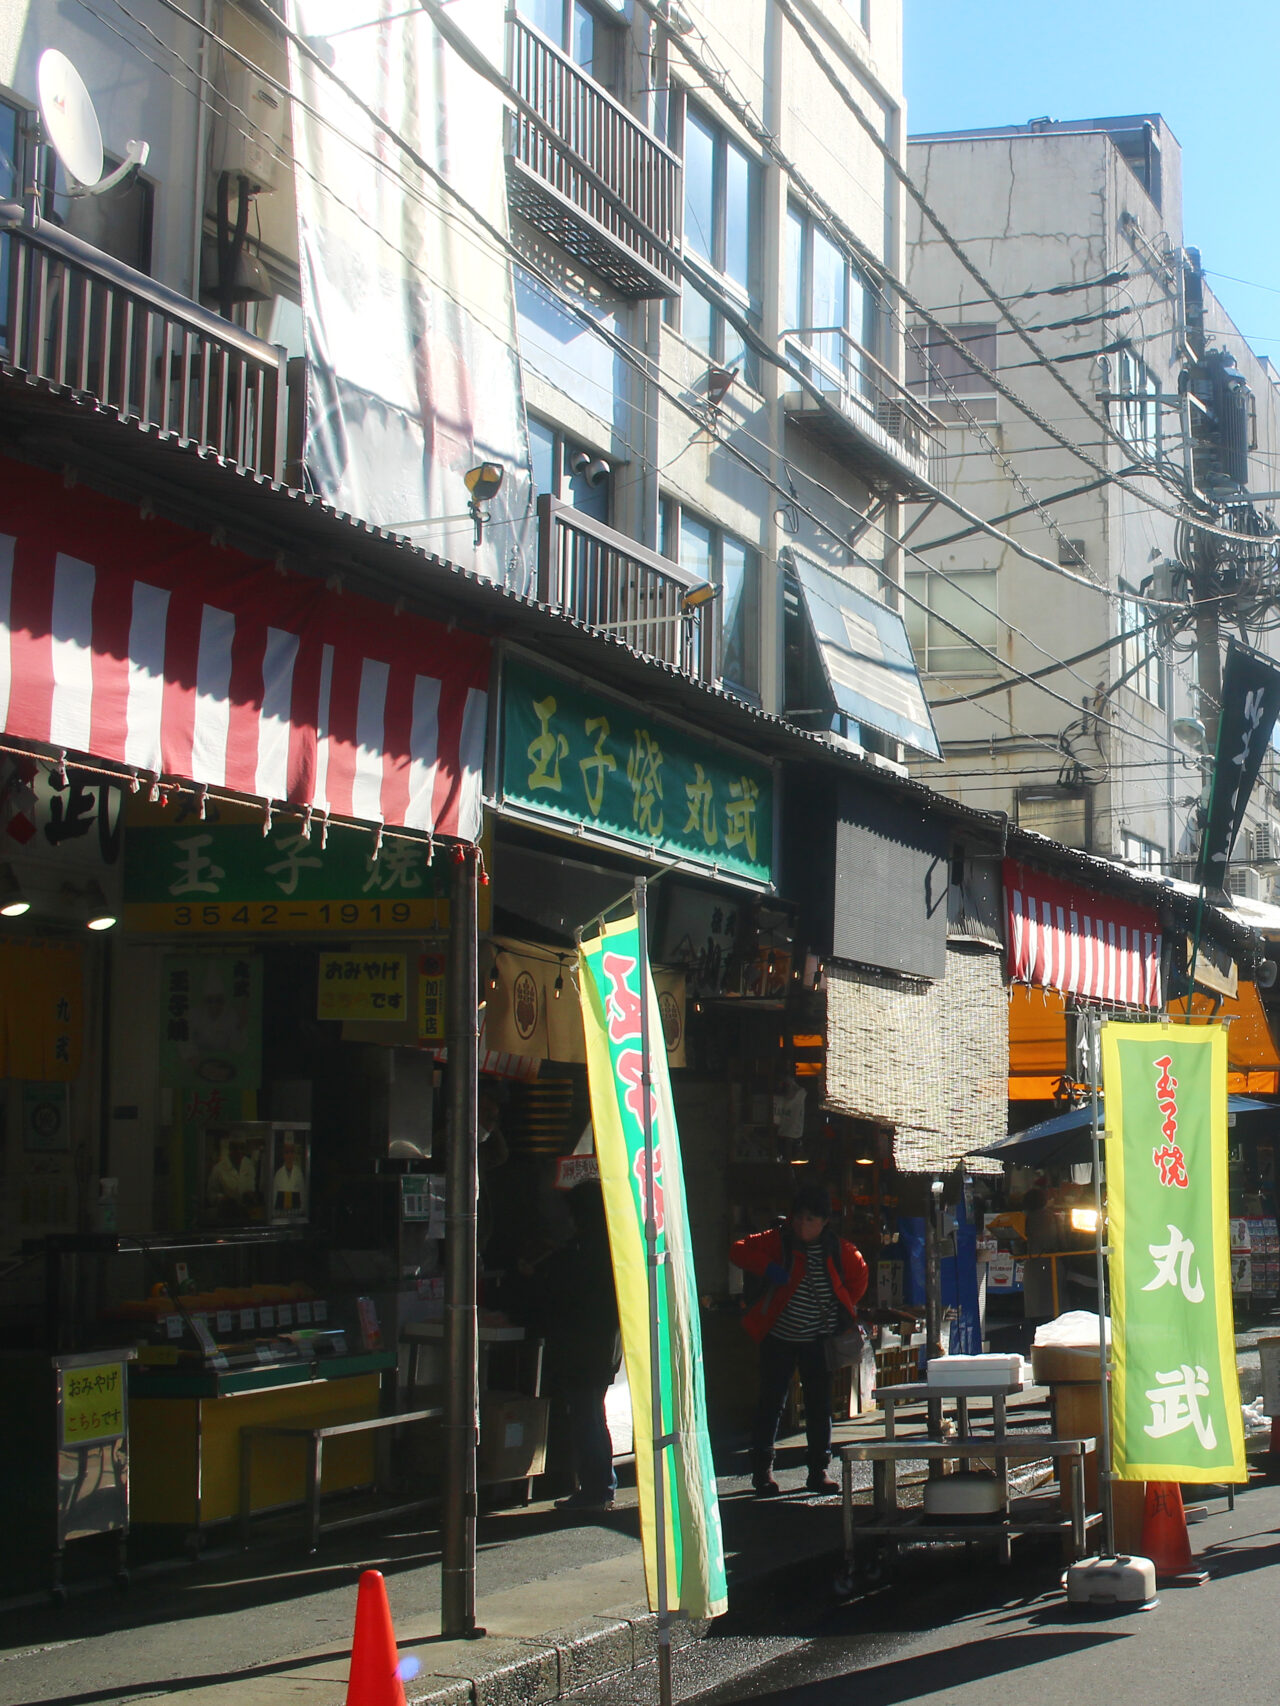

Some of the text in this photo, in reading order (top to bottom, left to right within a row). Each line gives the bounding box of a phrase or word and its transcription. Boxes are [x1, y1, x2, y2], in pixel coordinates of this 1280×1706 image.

[168, 833, 423, 897] 玉子焼
[173, 903, 412, 927] 3542-1919
[325, 960, 401, 982] おみやげ
[1152, 1054, 1190, 1190] 玉子焼
[1142, 1223, 1218, 1450] 丸武
[68, 1370, 119, 1398] おみやげ
[69, 1408, 121, 1433] こちらです
